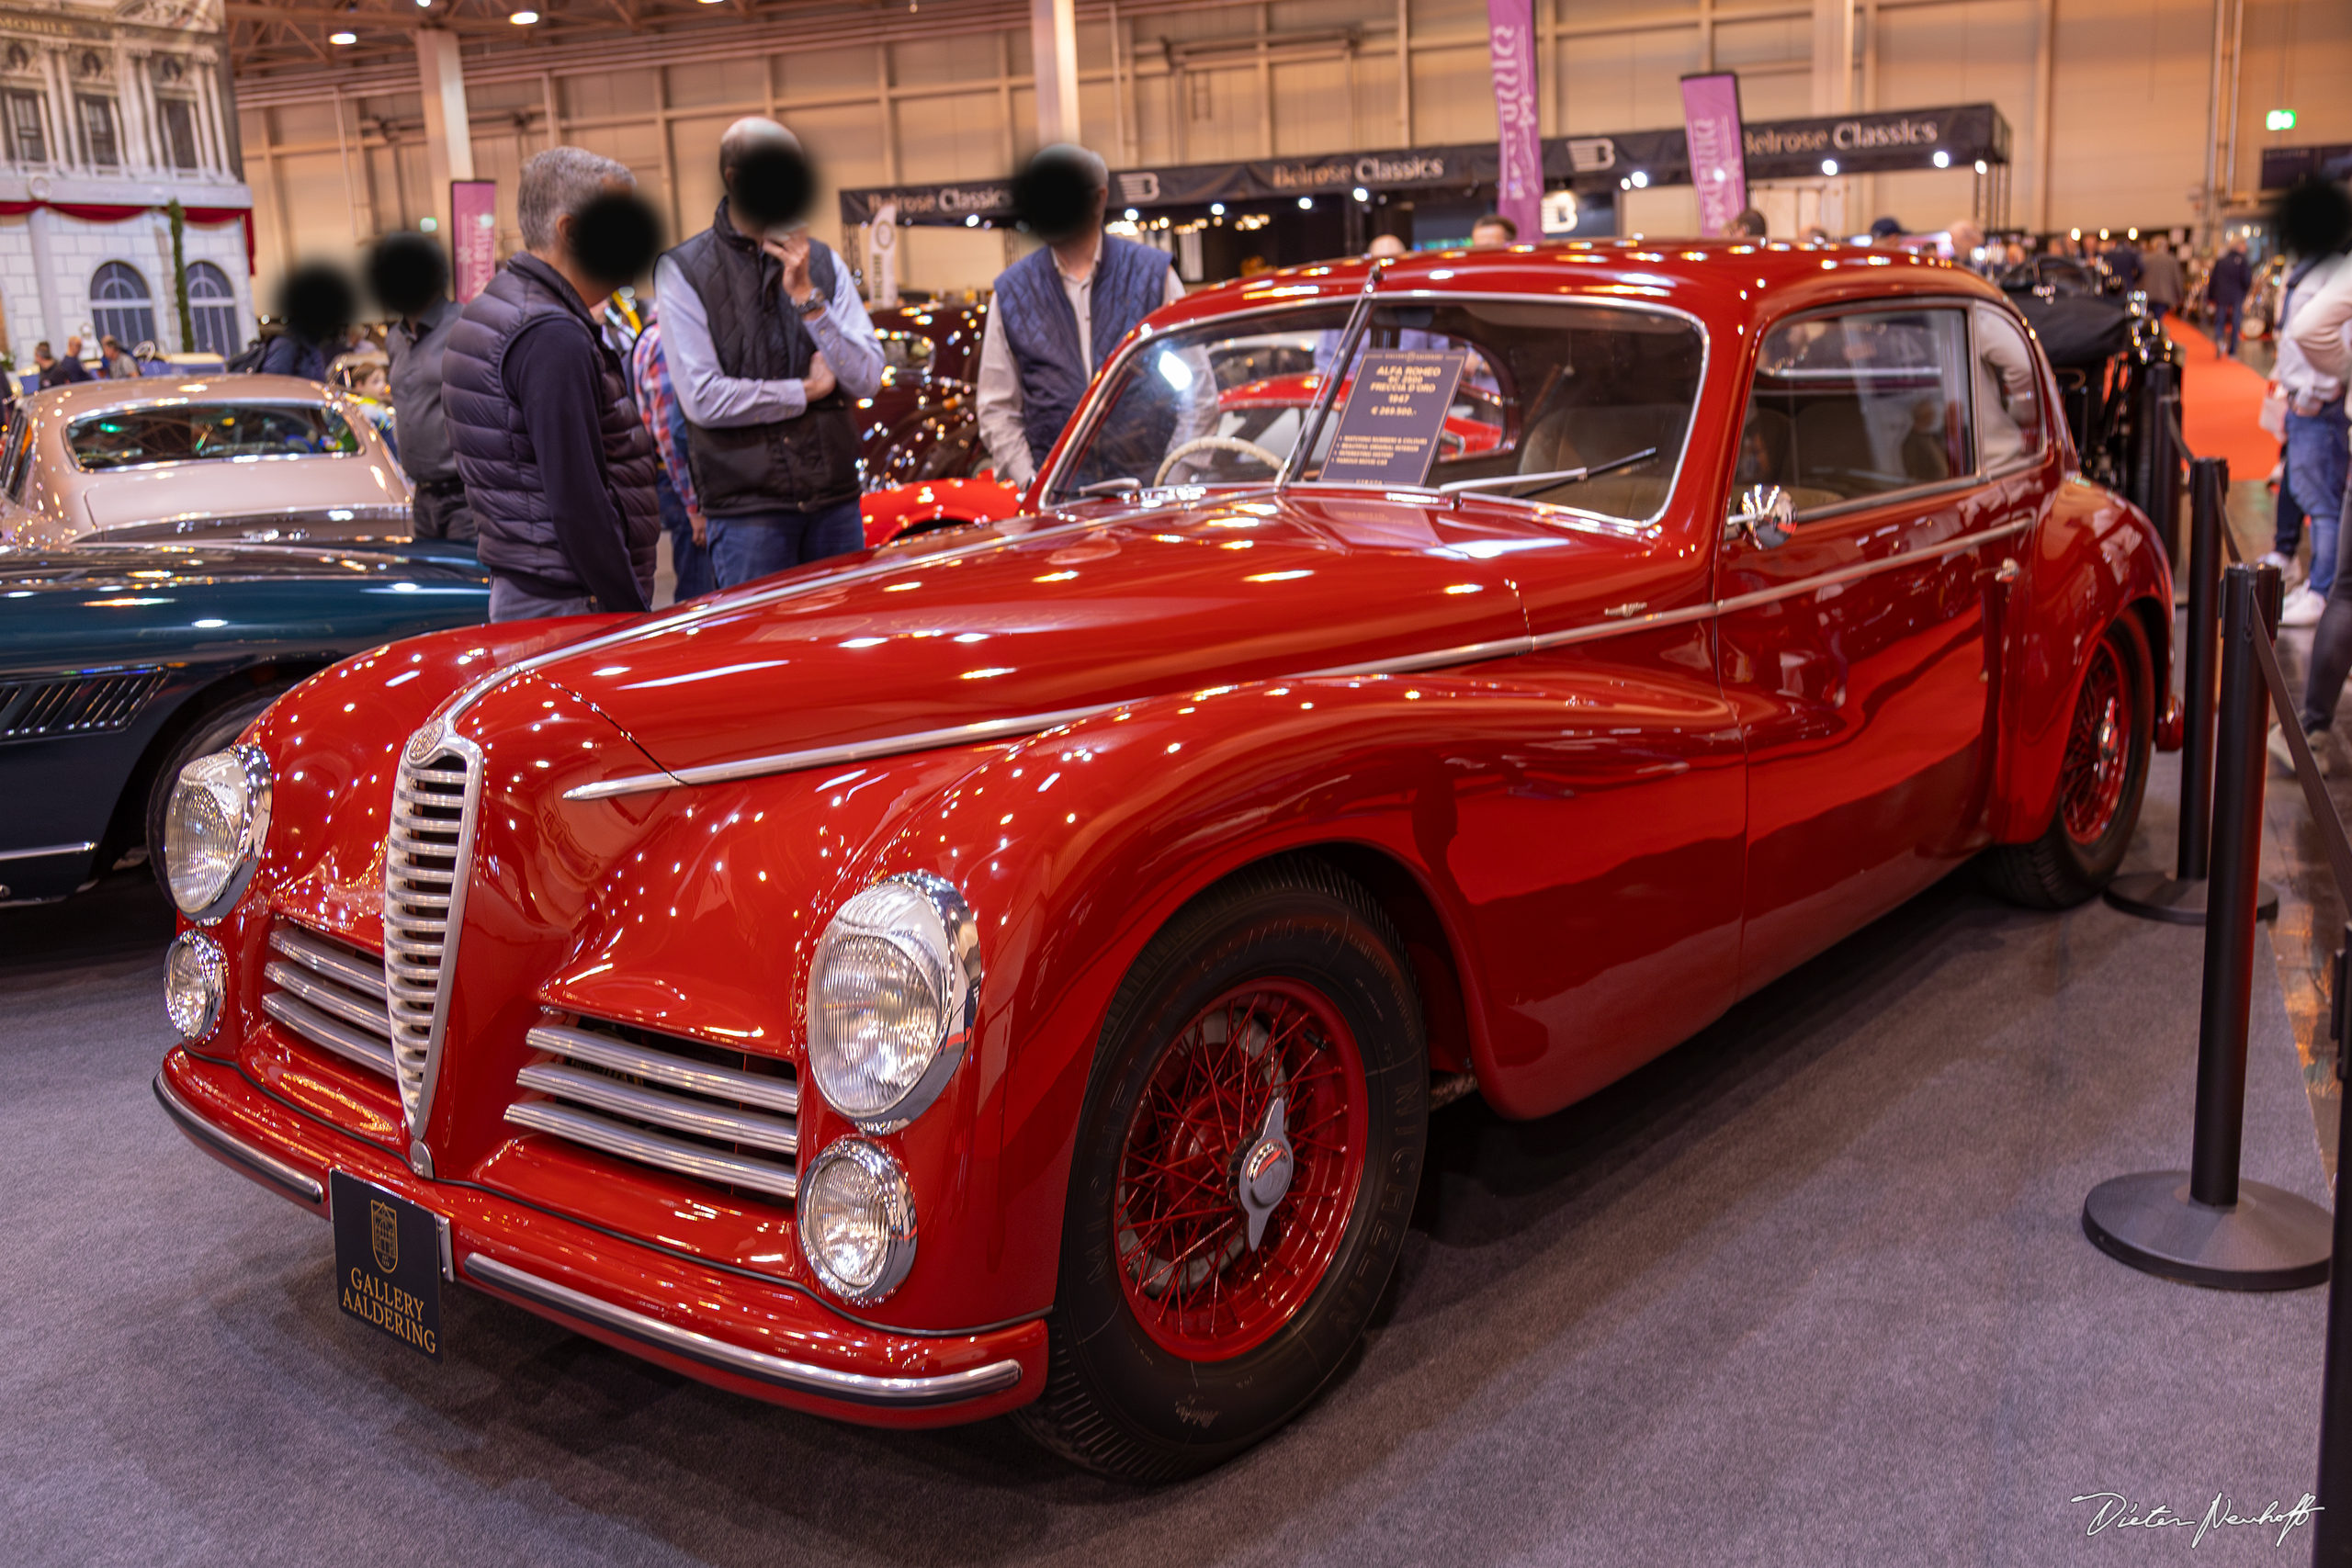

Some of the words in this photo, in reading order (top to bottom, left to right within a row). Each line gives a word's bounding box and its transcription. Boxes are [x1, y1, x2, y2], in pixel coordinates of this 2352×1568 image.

[1832, 118, 1939, 150] Classics
[1354, 155, 1444, 184] Classics
[1376, 365, 1403, 377] ALFA
[1404, 366, 1442, 378] ROMEO
[350, 1267, 425, 1323] GALLERY
[343, 1287, 436, 1355] AALDERING
